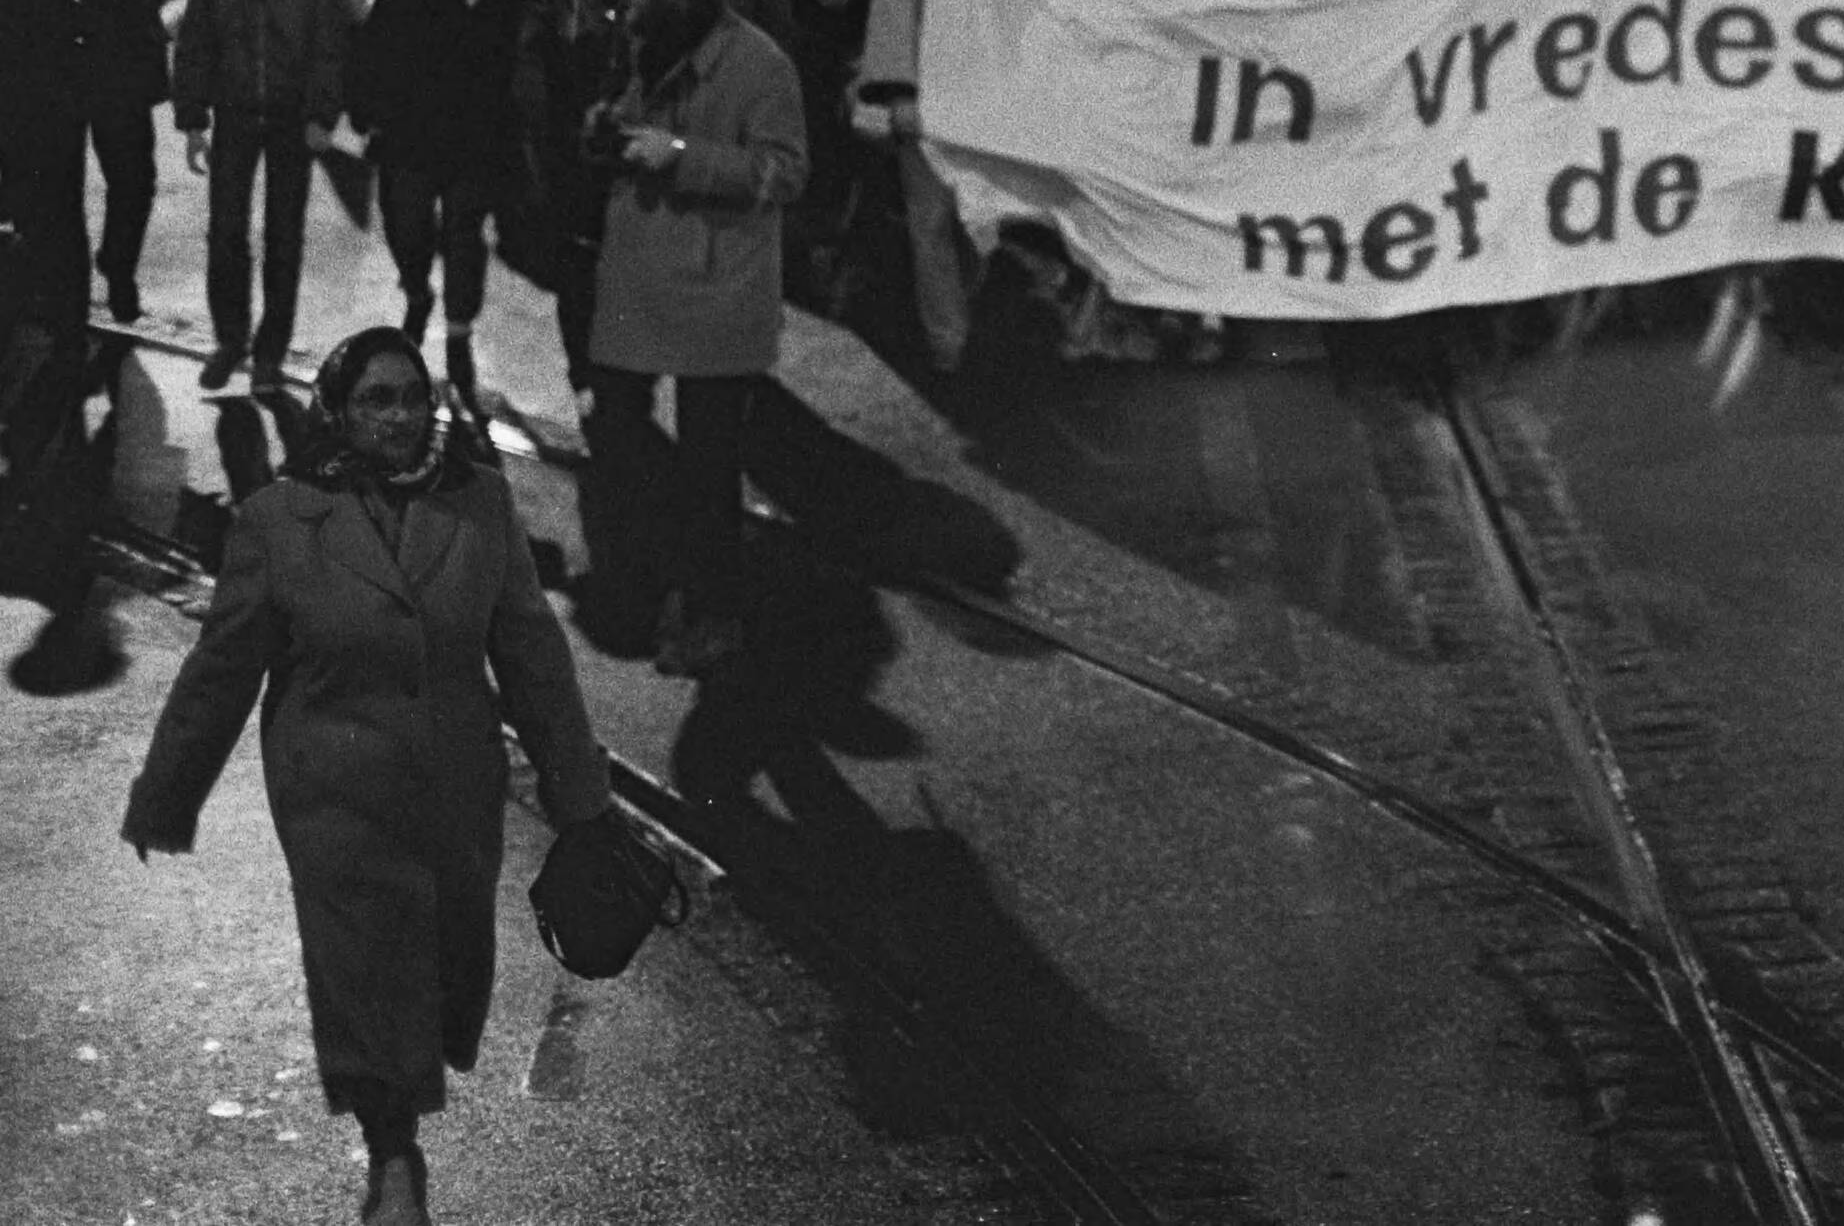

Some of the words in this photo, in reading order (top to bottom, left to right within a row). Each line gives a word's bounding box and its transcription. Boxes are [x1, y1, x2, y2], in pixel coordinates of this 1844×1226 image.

[1191, 54, 1318, 146] In
[1238, 157, 1487, 282] met
[1545, 129, 1701, 248] de
